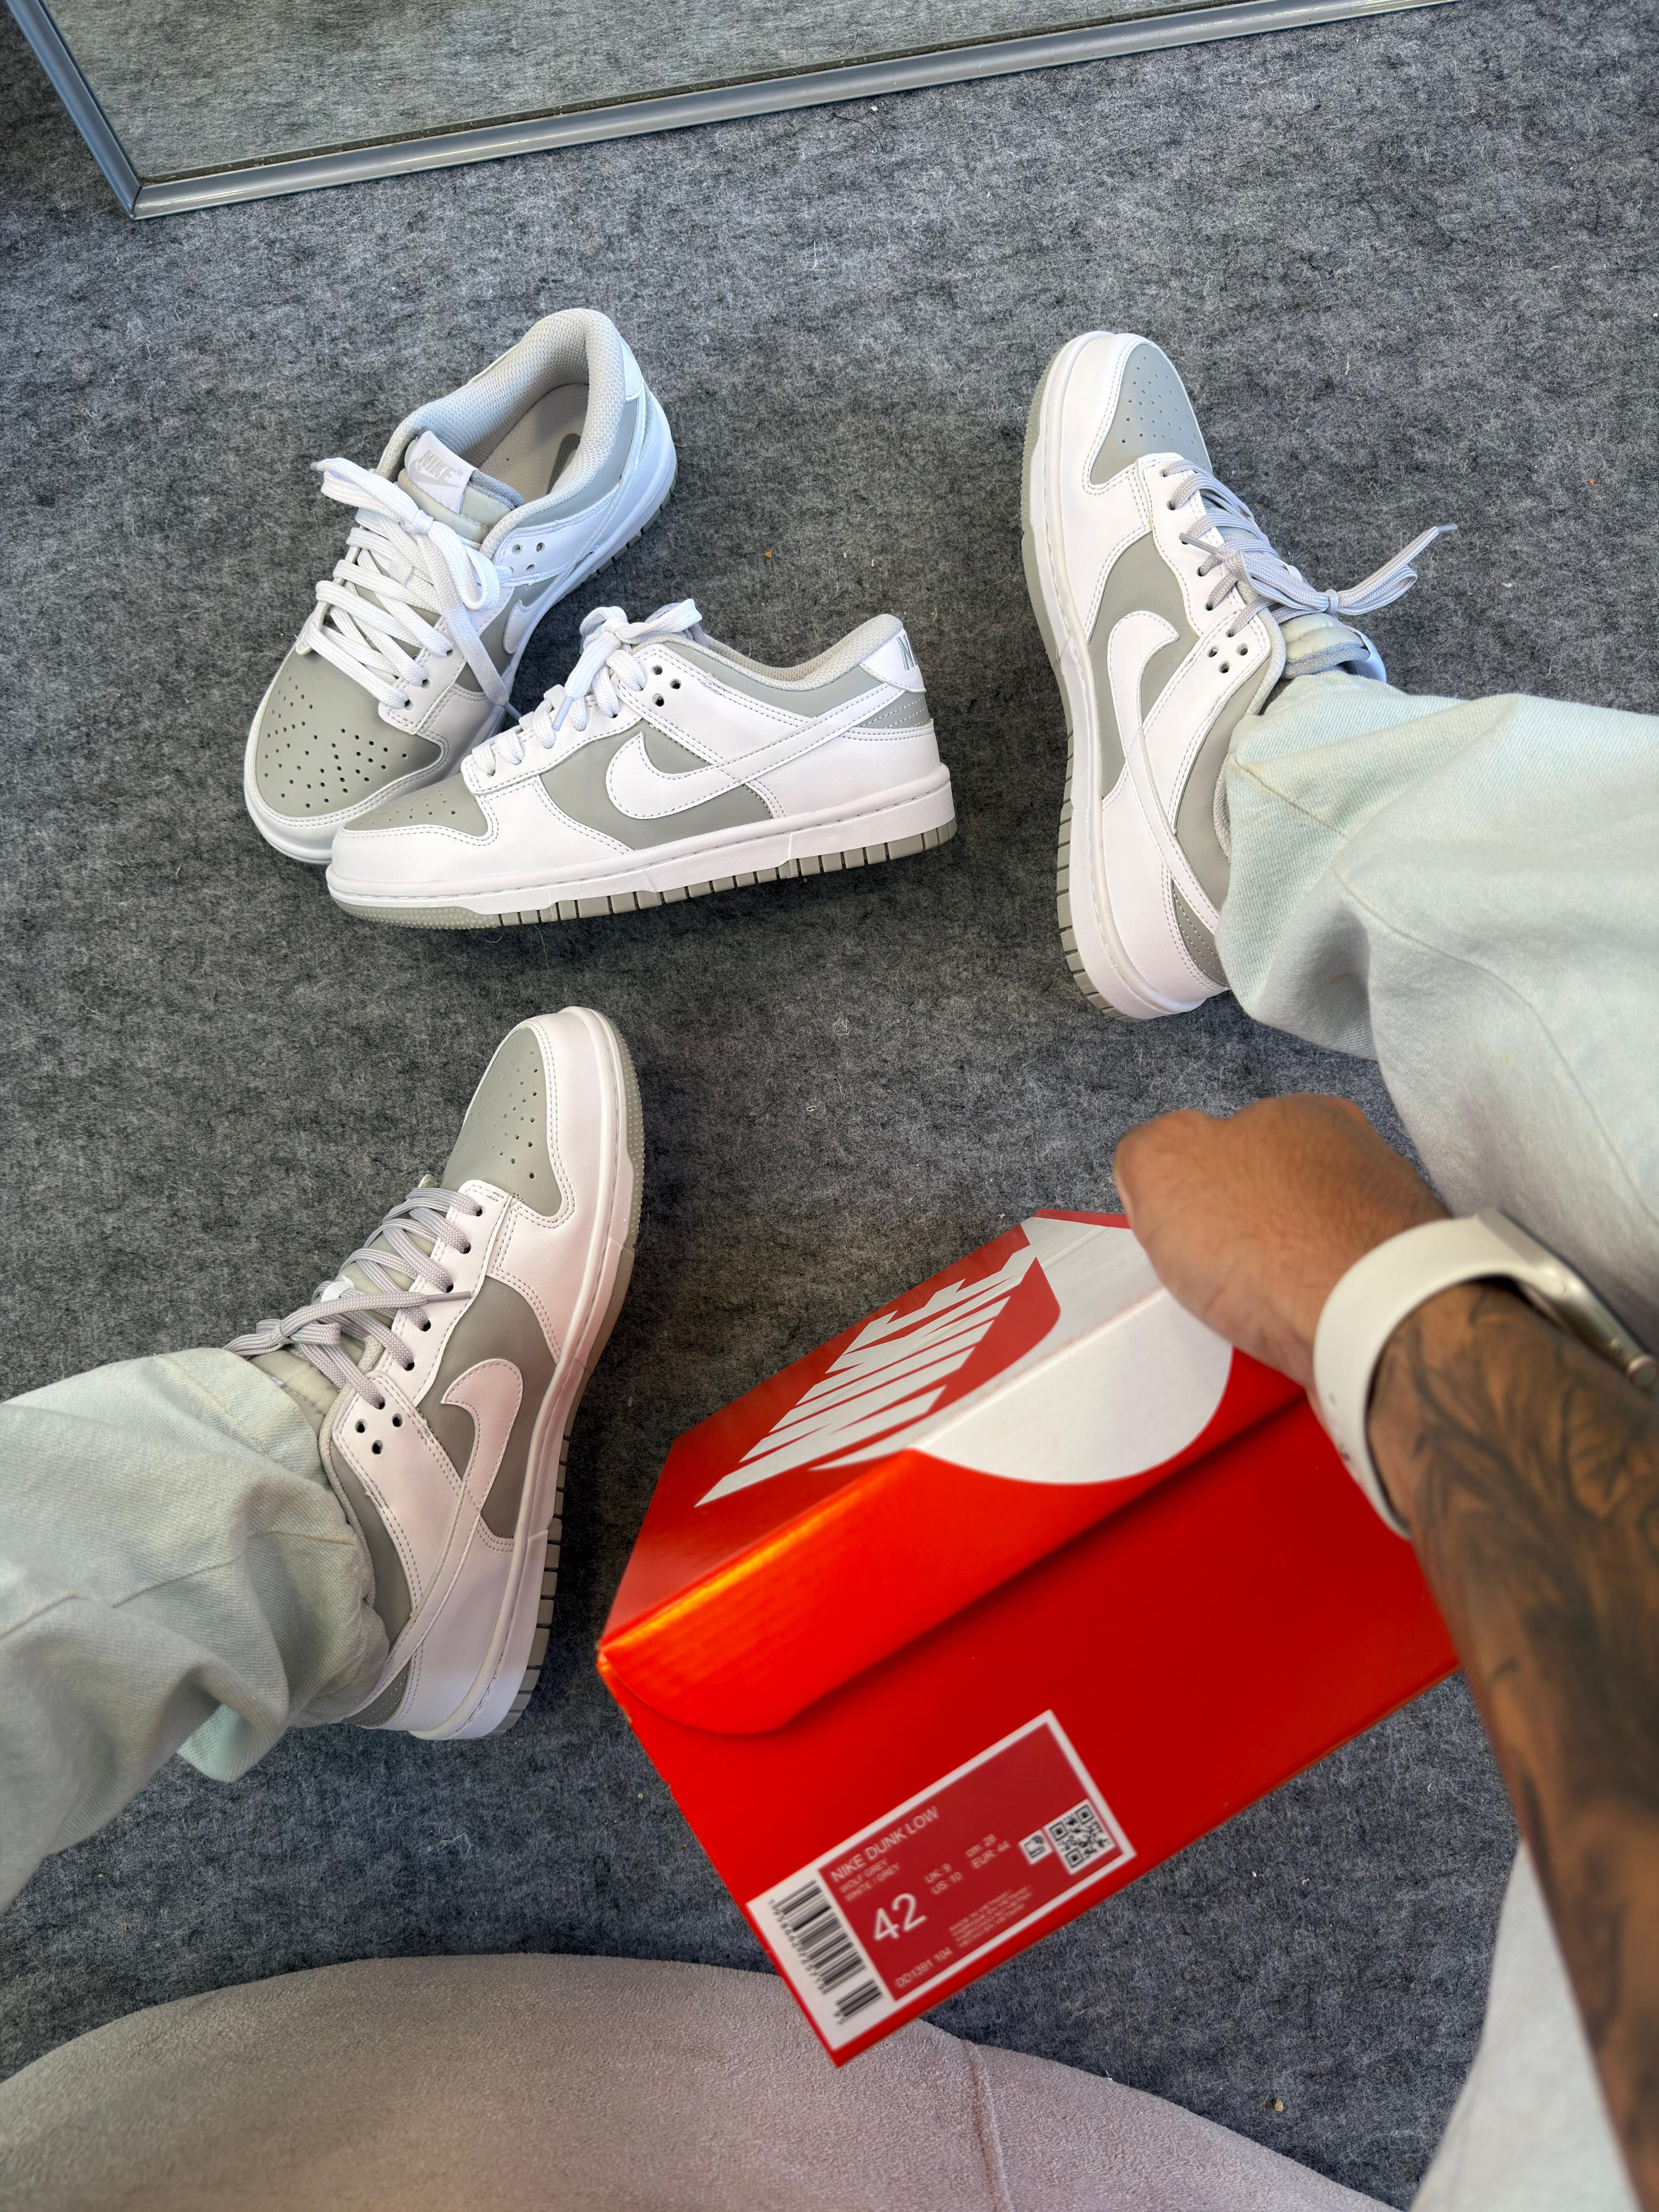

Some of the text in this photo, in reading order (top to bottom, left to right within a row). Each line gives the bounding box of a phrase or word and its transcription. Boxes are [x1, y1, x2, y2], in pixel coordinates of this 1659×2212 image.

[417, 449, 456, 480] NIKE
[694, 1245, 1024, 1507] NIKE
[831, 1806, 939, 1882] NIKE DUNK LOW
[966, 1844, 982, 1857] cm:
[972, 1841, 1009, 1869] EUR: 44
[839, 1858, 887, 1892] WOLF GREY
[844, 1881, 872, 1901] WHITE
[877, 1863, 900, 1881] GREY
[925, 1863, 951, 1883] UK: 9
[932, 1871, 962, 1894] US: 10
[874, 1892, 927, 1940] 42
[895, 1947, 952, 1987] DD1391 104
